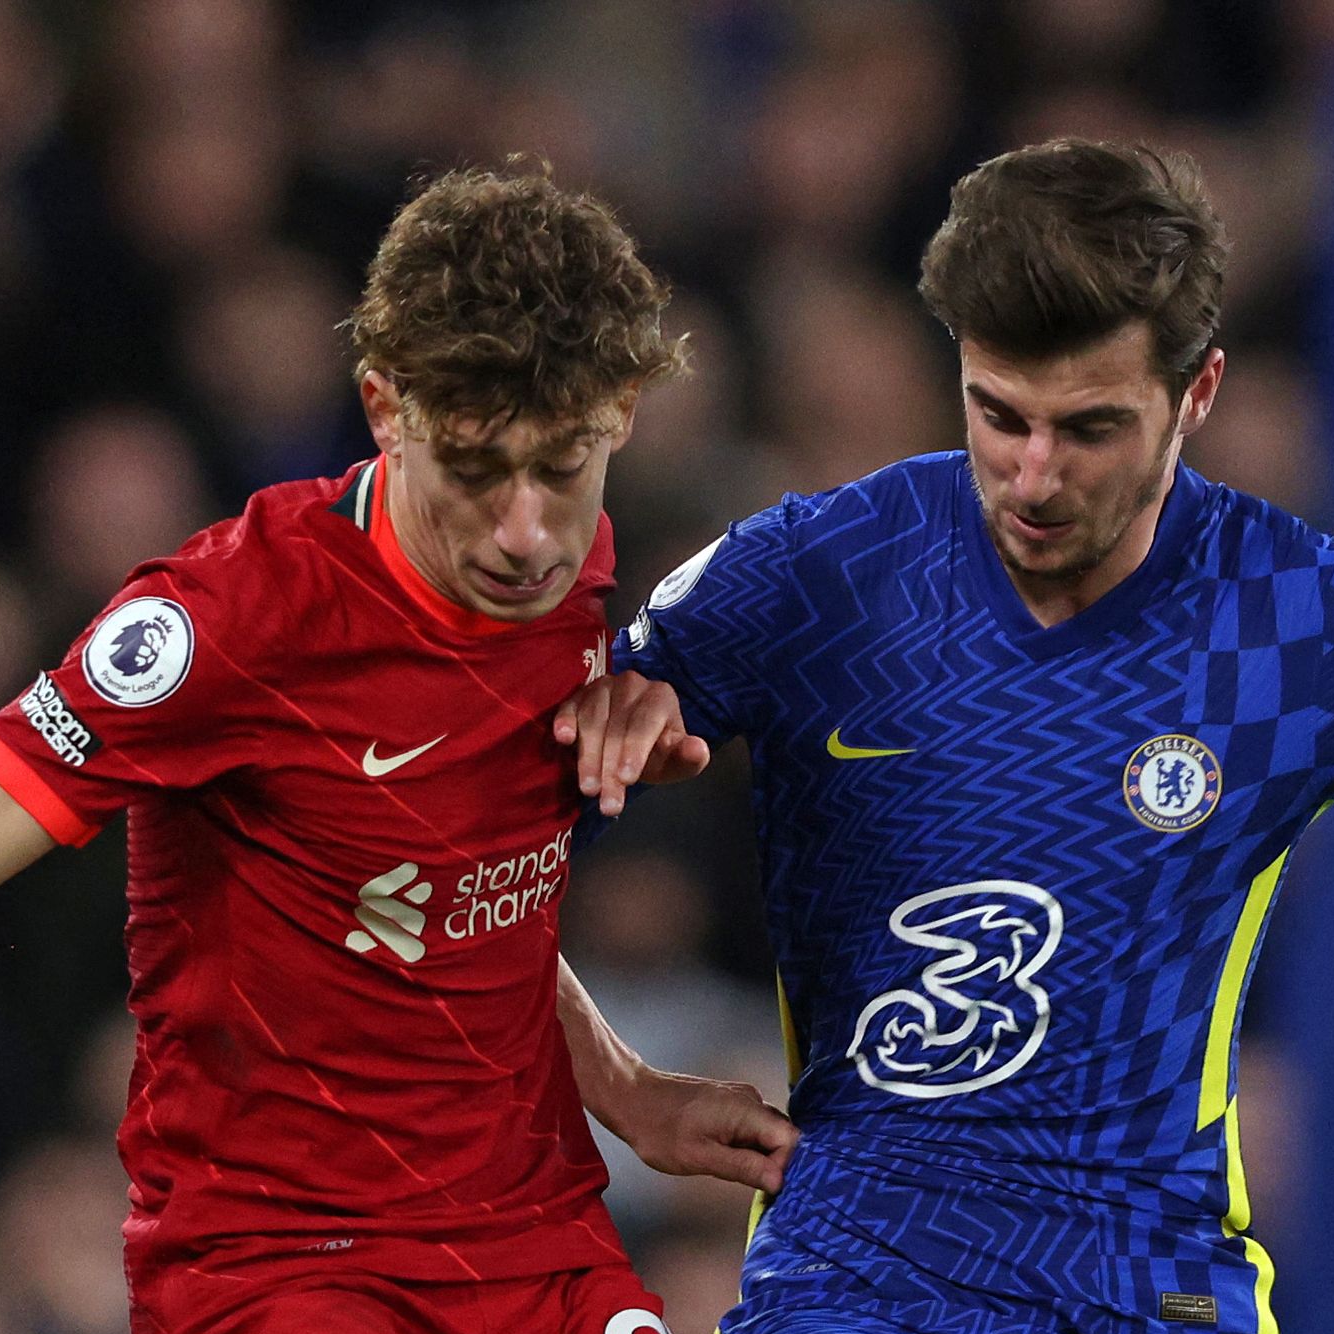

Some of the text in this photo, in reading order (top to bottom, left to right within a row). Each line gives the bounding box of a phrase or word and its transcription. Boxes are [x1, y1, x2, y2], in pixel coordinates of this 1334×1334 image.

[34, 670, 55, 703] No
[101, 670, 164, 693] Premier League
[26, 706, 86, 767] racism
[1143, 738, 1206, 763] CHELSEA
[846, 879, 1064, 1098] 3
